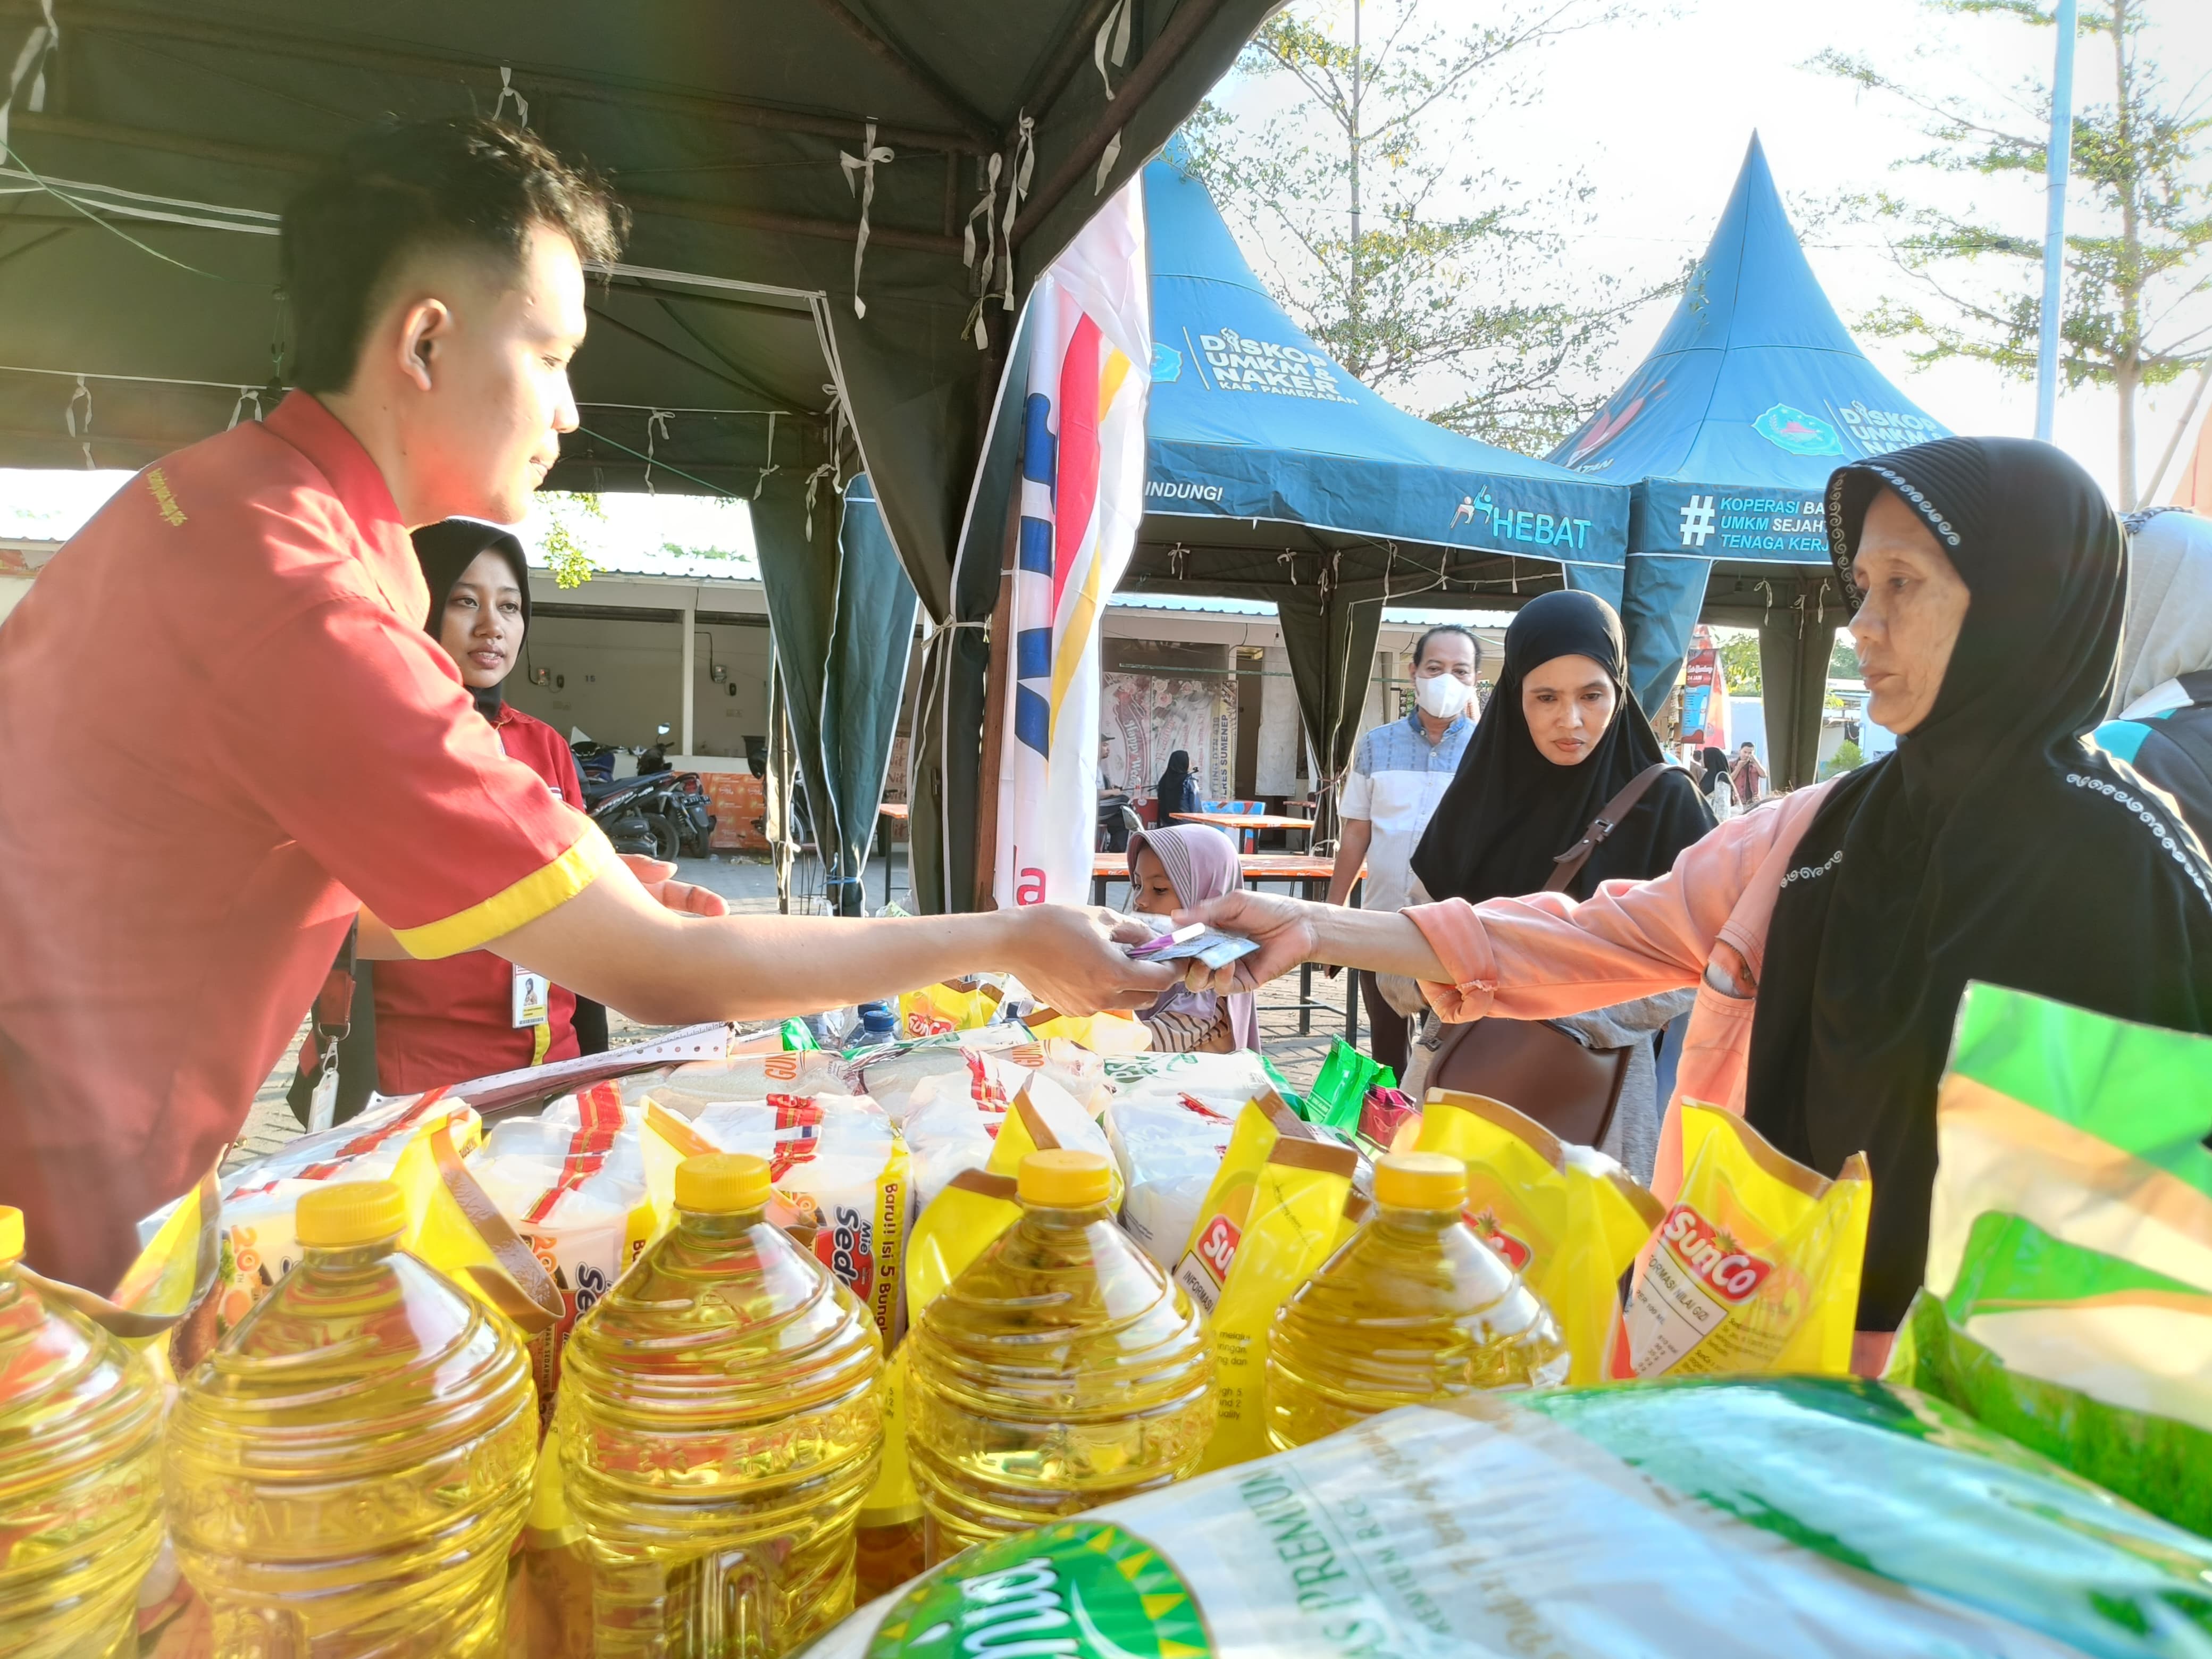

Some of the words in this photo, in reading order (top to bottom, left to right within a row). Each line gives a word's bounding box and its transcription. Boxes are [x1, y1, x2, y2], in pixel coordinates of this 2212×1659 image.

[1205, 352, 1311, 376] UMKM
[1314, 367, 1339, 383] &
[1212, 367, 1340, 395] NAKER
[1219, 381, 1258, 392] KAB.
[1262, 386, 1359, 406] PAMEKASAN
[1850, 425, 1930, 443] UMKM
[1720, 498, 1800, 514] KOPERASI
[1493, 507, 1592, 550] HEBAT
[1721, 518, 1769, 531] UMKM
[1721, 534, 1784, 550] TENAGA
[858, 1219, 873, 1256] Mie
[882, 1239, 894, 1261] Isi
[1663, 1211, 1756, 1294] SunCo
[881, 1264, 895, 1277] 5
[1183, 1270, 1213, 1311] INFORMASI
[1673, 1287, 1692, 1310] NILAI
[1692, 1306, 1710, 1322] GIZI
[1230, 1356, 1247, 1365] dan
[1237, 1388, 1242, 1396] 5
